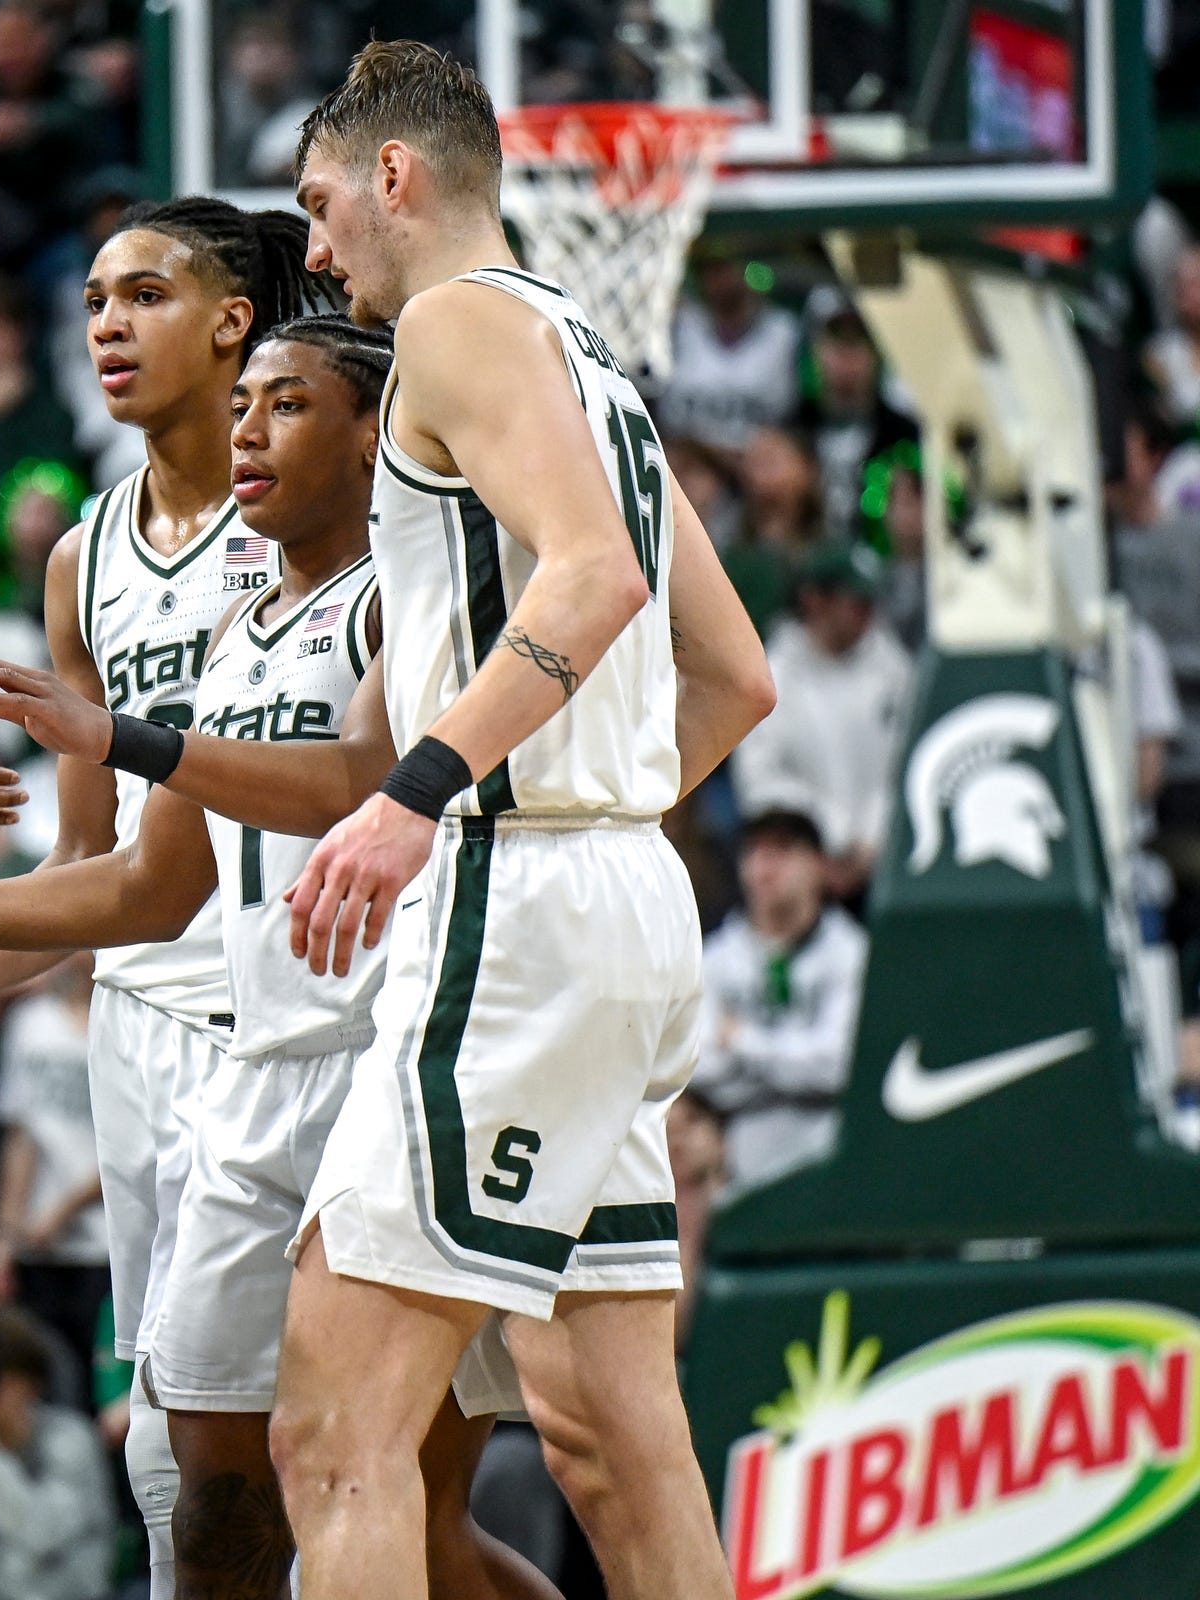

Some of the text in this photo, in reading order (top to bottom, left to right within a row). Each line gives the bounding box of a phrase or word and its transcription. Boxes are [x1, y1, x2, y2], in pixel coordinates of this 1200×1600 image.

[605, 394, 663, 604] 15
[107, 628, 212, 714] Stat
[481, 1125, 542, 1205] S
[735, 1347, 1192, 1600] LIBMAN
